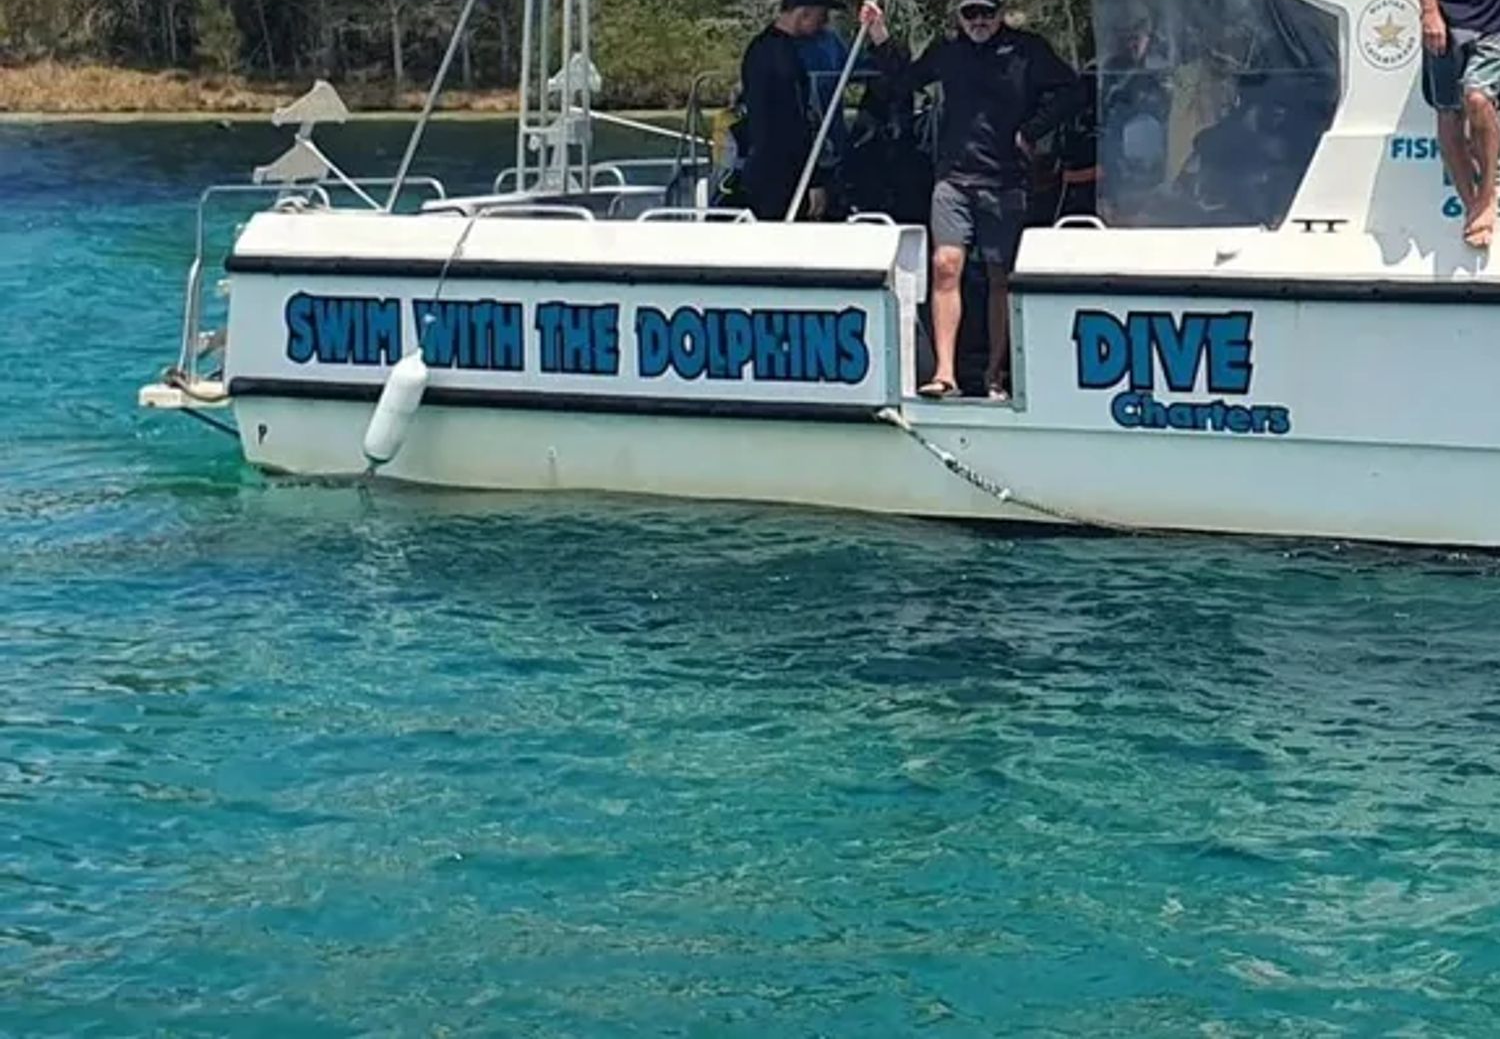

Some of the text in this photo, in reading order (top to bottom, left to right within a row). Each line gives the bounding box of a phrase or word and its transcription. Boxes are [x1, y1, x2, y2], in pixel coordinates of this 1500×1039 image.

[285, 291, 870, 385] SWIM WITH THE DOLPHINS
[1072, 309, 1252, 394] DIVE
[1111, 390, 1291, 434] Charters
